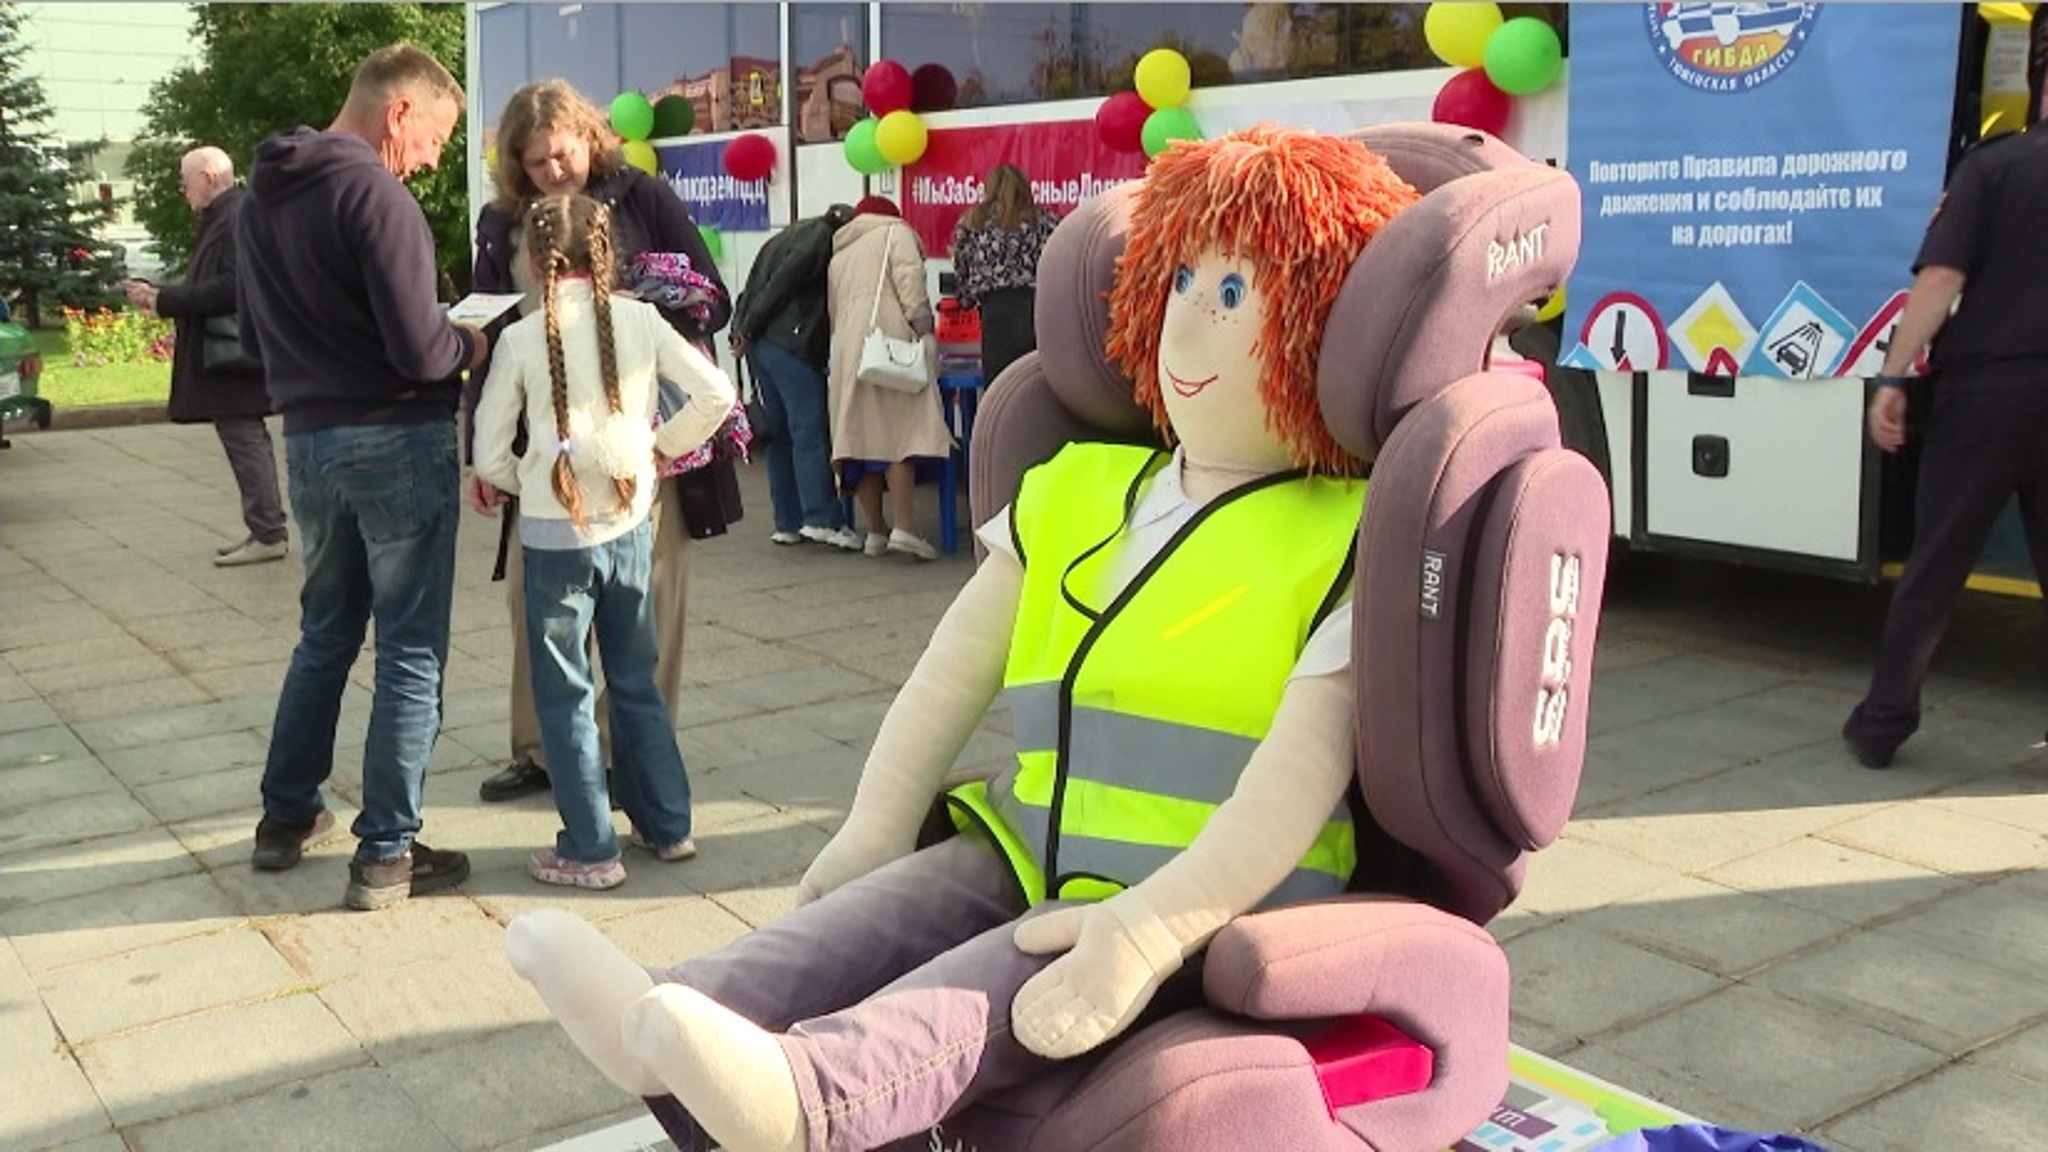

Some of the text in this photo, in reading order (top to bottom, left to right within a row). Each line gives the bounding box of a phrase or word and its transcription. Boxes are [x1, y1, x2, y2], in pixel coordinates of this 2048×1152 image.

[1744, 49, 1796, 88] ОБЛАСТЬ
[1590, 149, 1907, 183] Повторите Правила дорожного
[1600, 184, 1883, 216] движения и соблюдайте их
[1487, 222, 1549, 278] RANT
[1672, 220, 1793, 248] на дорогах!
[1421, 555, 1442, 616] RANT
